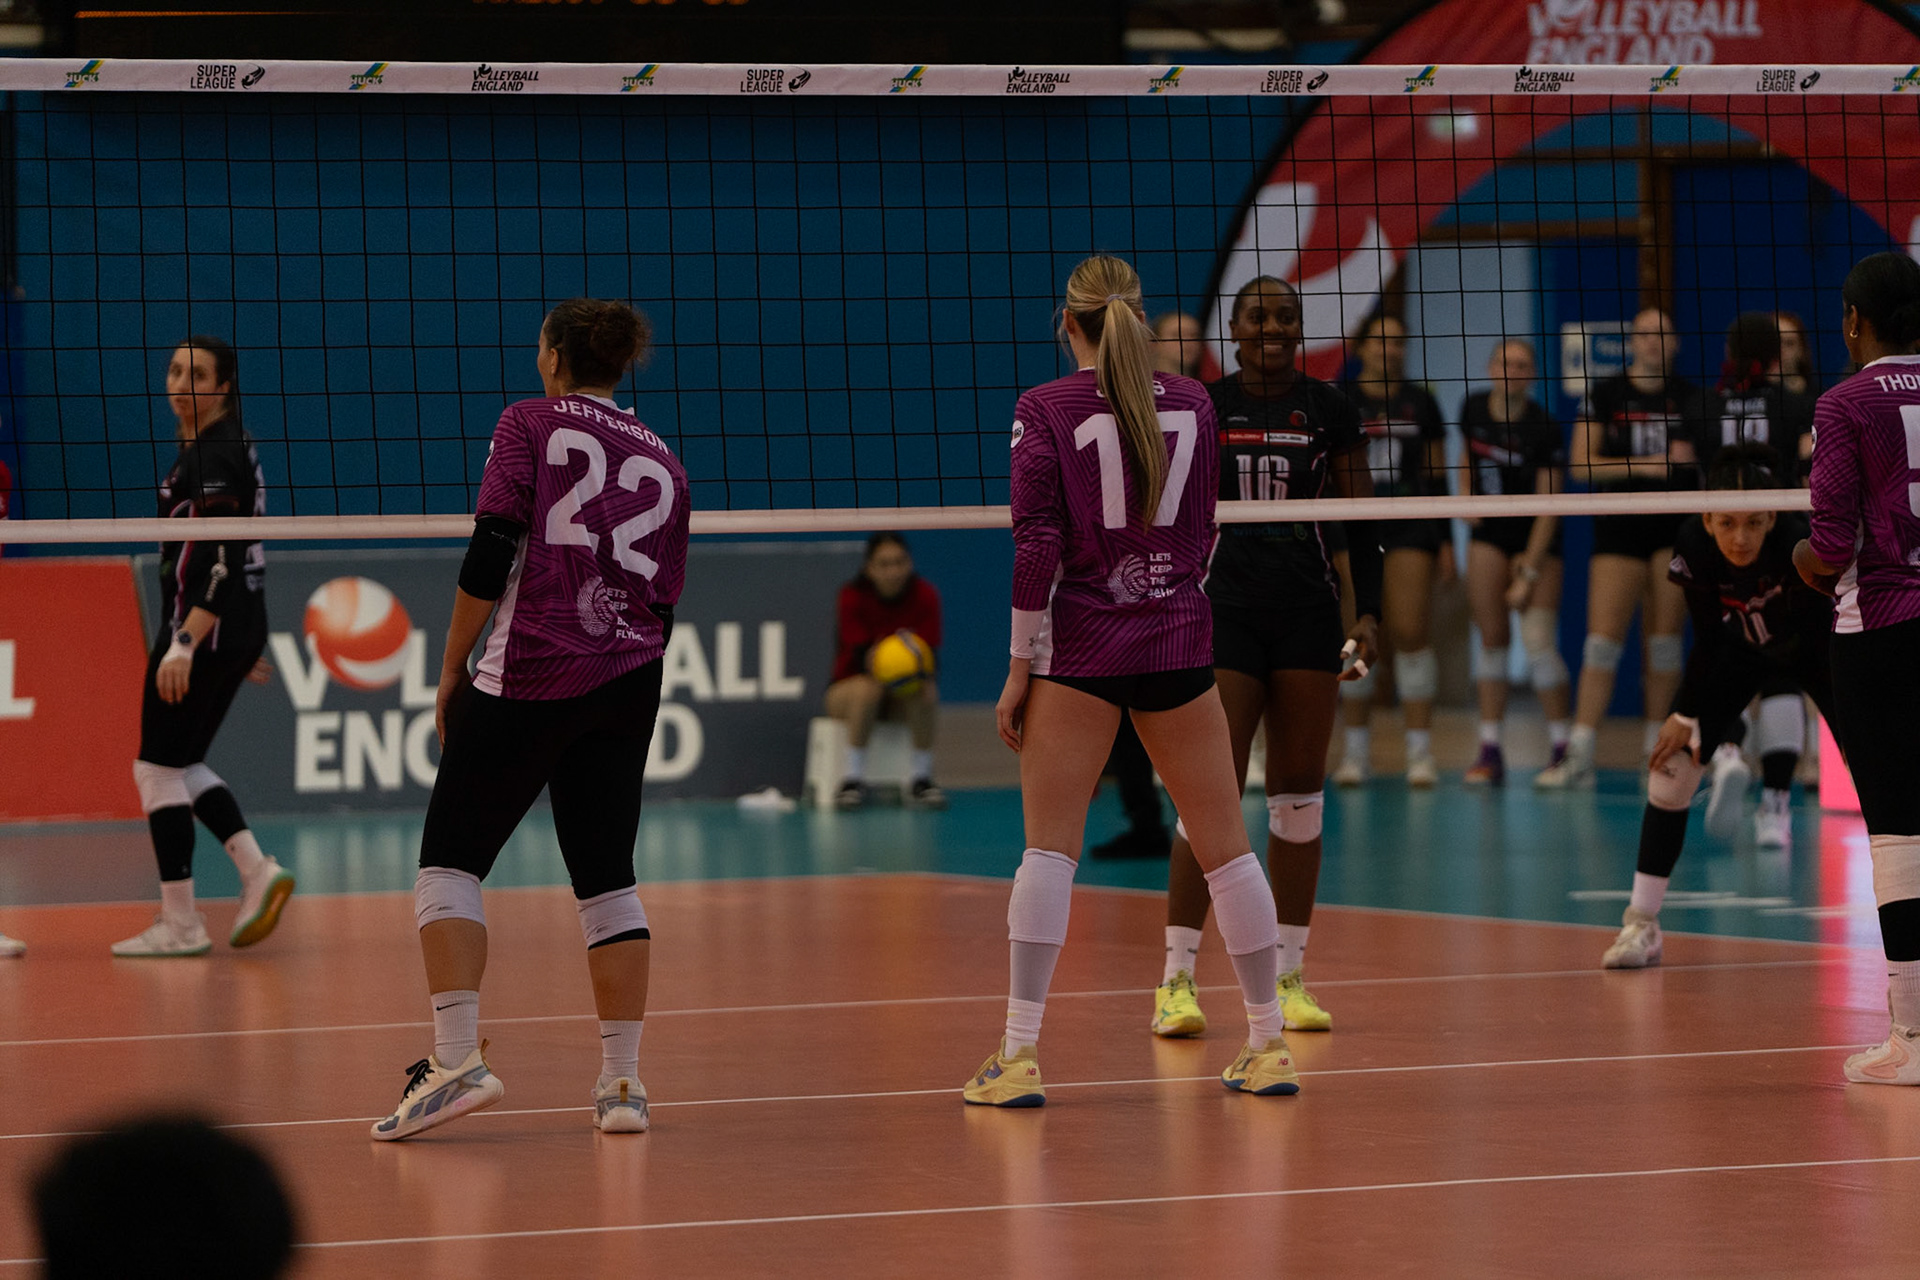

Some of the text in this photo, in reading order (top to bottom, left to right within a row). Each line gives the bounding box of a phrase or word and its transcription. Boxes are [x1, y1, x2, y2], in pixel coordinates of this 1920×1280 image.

[197, 65, 237, 77] SUPER
[747, 69, 784, 81] SUPER
[1267, 70, 1303, 81] SUPER
[1762, 70, 1796, 81] SUPER
[190, 77, 236, 89] LEAGUE
[471, 81, 524, 92] ENGLAND
[740, 81, 783, 92] LEAGUE
[1006, 83, 1056, 93] ENGLAND
[1260, 81, 1302, 93] LEAGUE
[1514, 82, 1561, 92] ENGLAND
[1756, 81, 1795, 92] LEAGUE
[1873, 373, 1920, 392] THO
[553, 400, 669, 455] JEFFERSON
[1074, 410, 1198, 529] 17
[1236, 455, 1290, 500] 16
[545, 427, 675, 581] 22
[606, 587, 628, 599] ETS
[609, 600, 629, 611] EP
